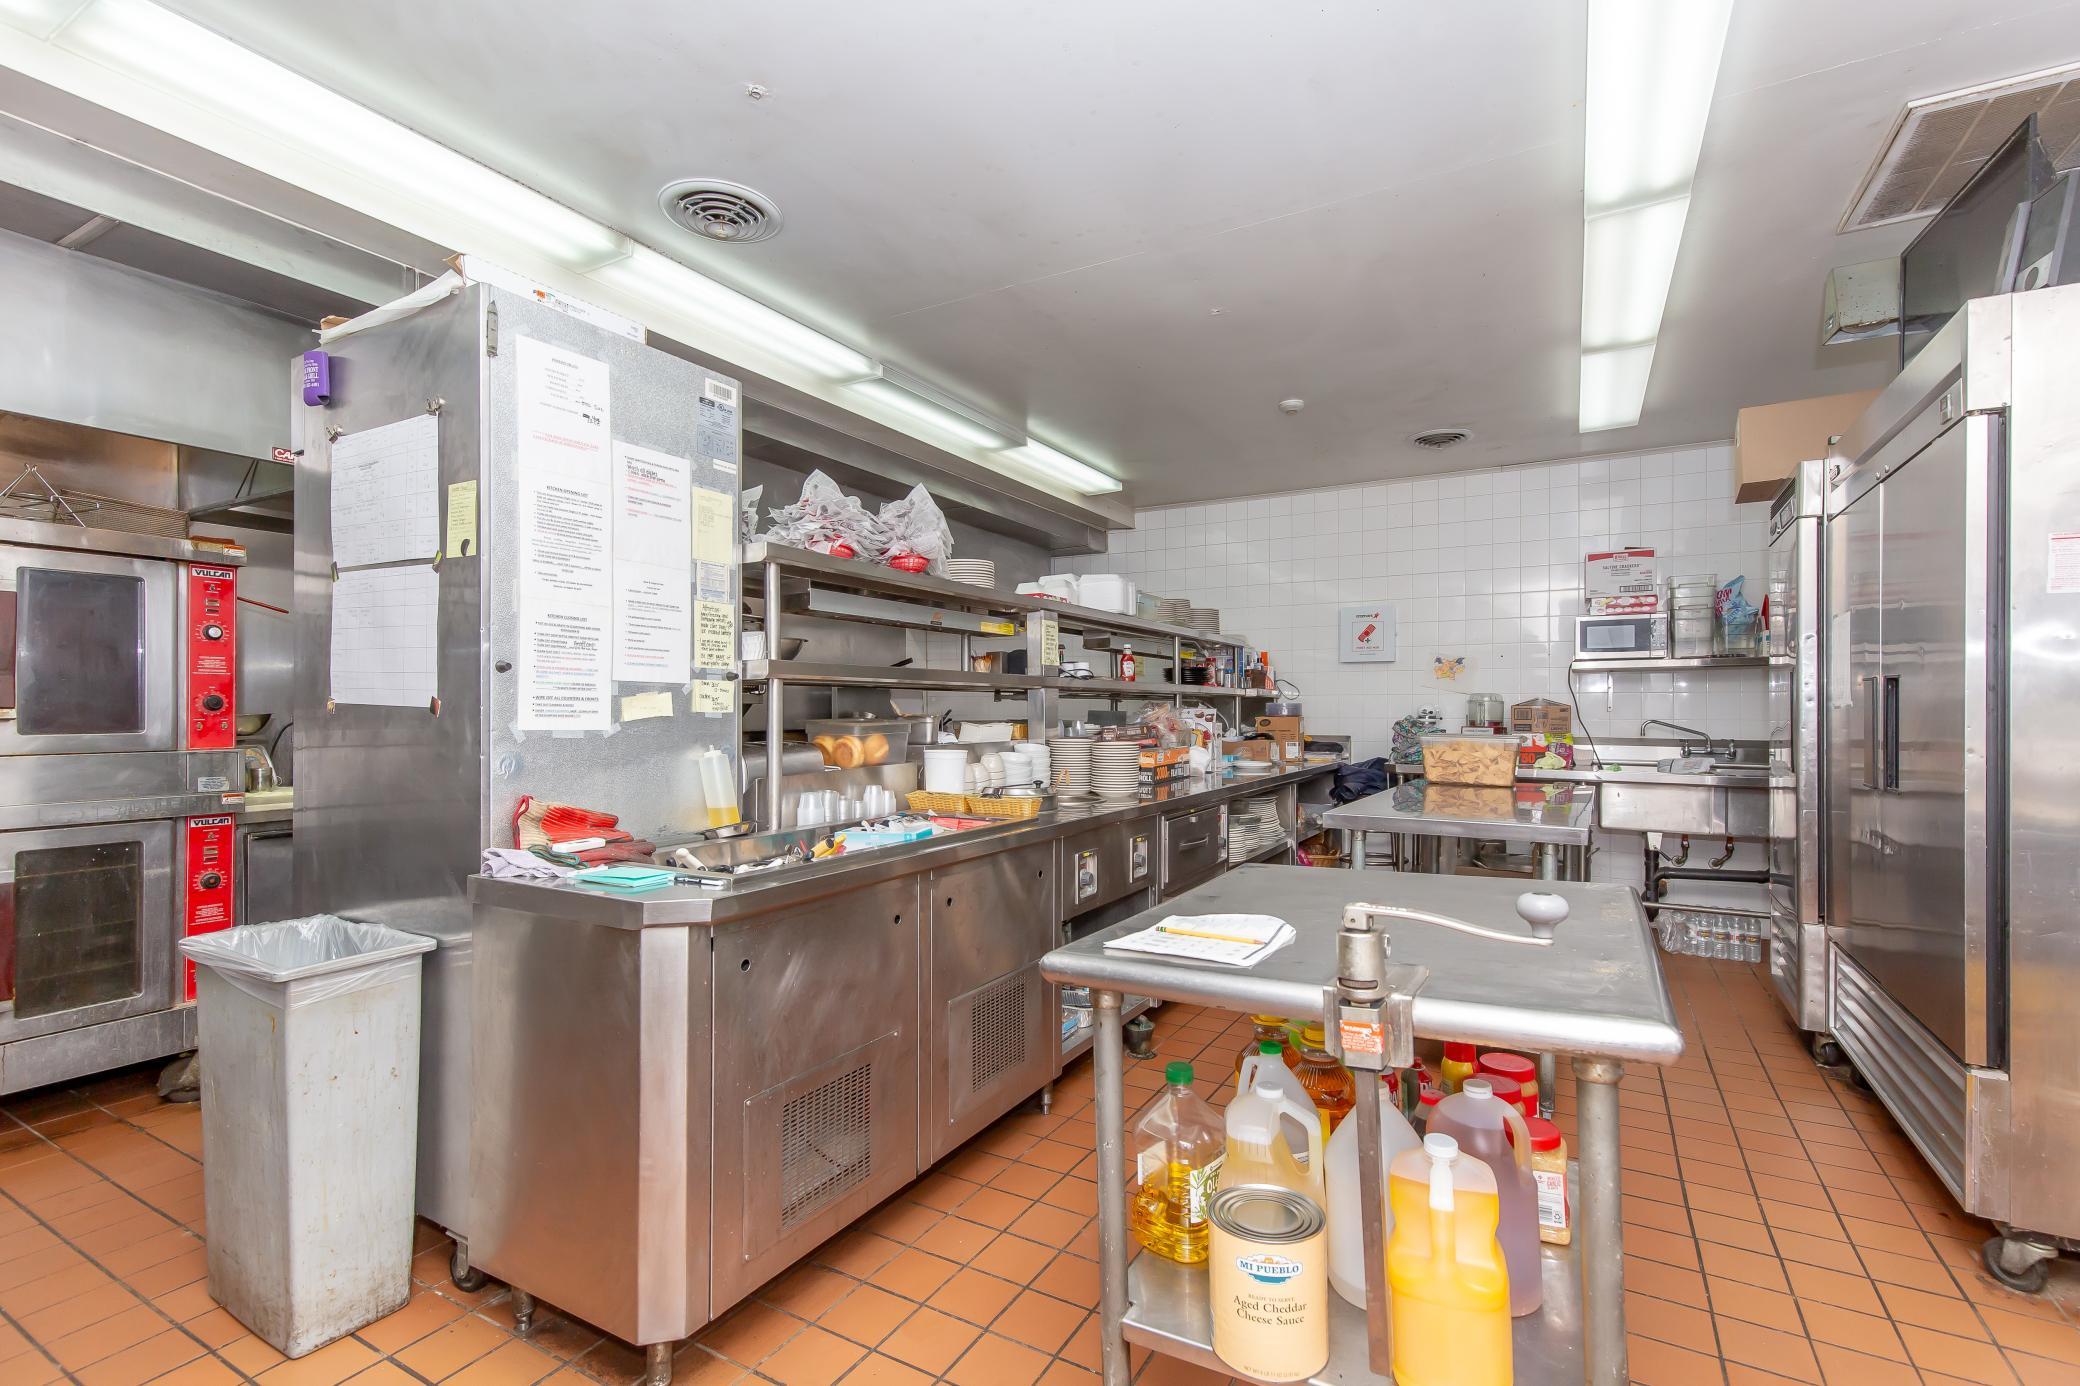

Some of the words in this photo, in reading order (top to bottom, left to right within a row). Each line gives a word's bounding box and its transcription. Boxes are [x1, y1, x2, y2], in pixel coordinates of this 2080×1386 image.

[194, 569, 231, 579] VULCAN
[193, 818, 230, 826] VULCAN
[1239, 1260, 1253, 1271] MI
[1256, 1264, 1300, 1275] PUEBLO
[1233, 1295, 1259, 1312] Aged
[1263, 1302, 1308, 1314] Cheddar
[1236, 1307, 1273, 1325] Cheese
[1276, 1315, 1305, 1326] Sauce
